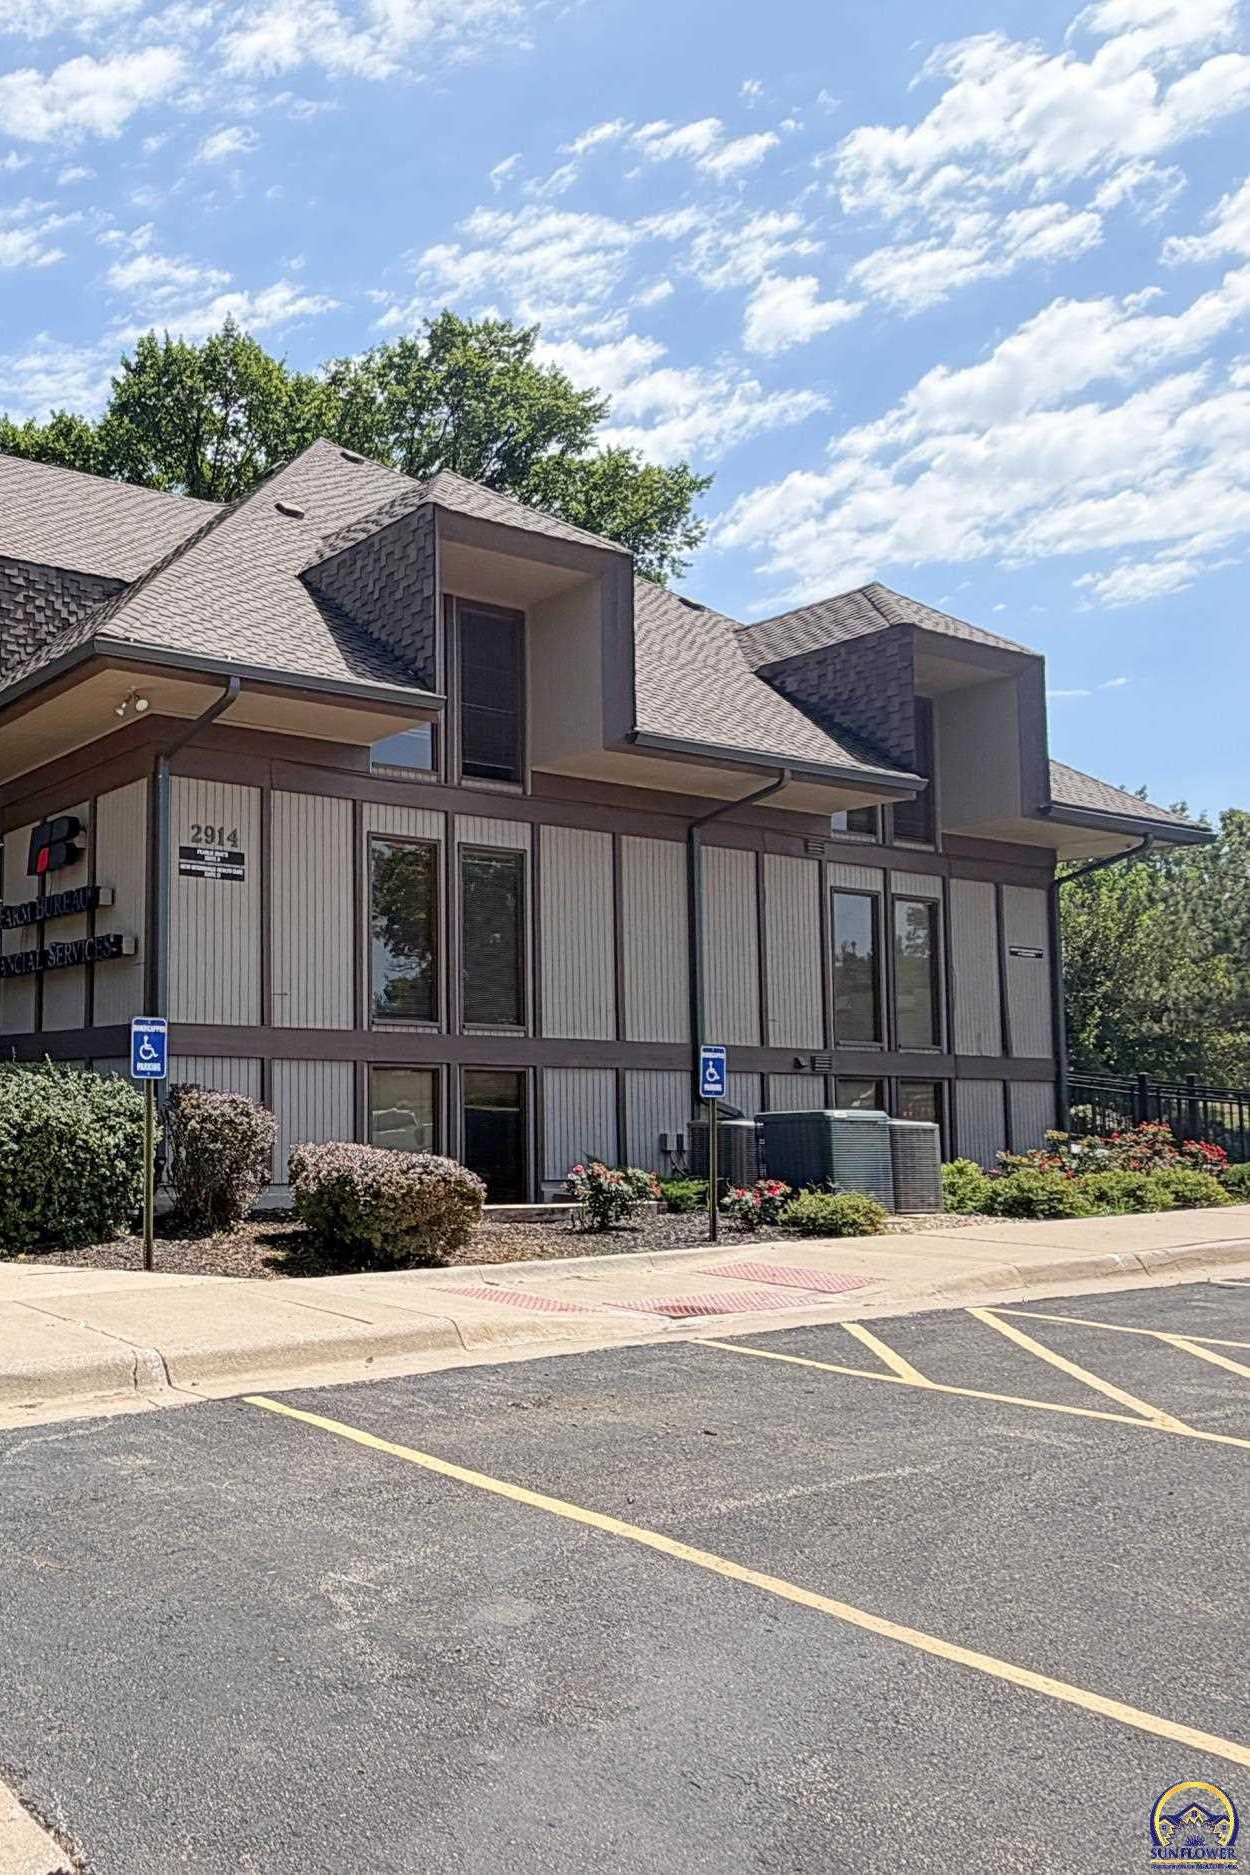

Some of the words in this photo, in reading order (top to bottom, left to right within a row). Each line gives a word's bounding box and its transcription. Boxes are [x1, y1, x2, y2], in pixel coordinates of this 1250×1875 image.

[191, 824, 238, 848] 2914
[35, 886, 98, 920] BUREAU
[47, 934, 120, 969] SERVICES
